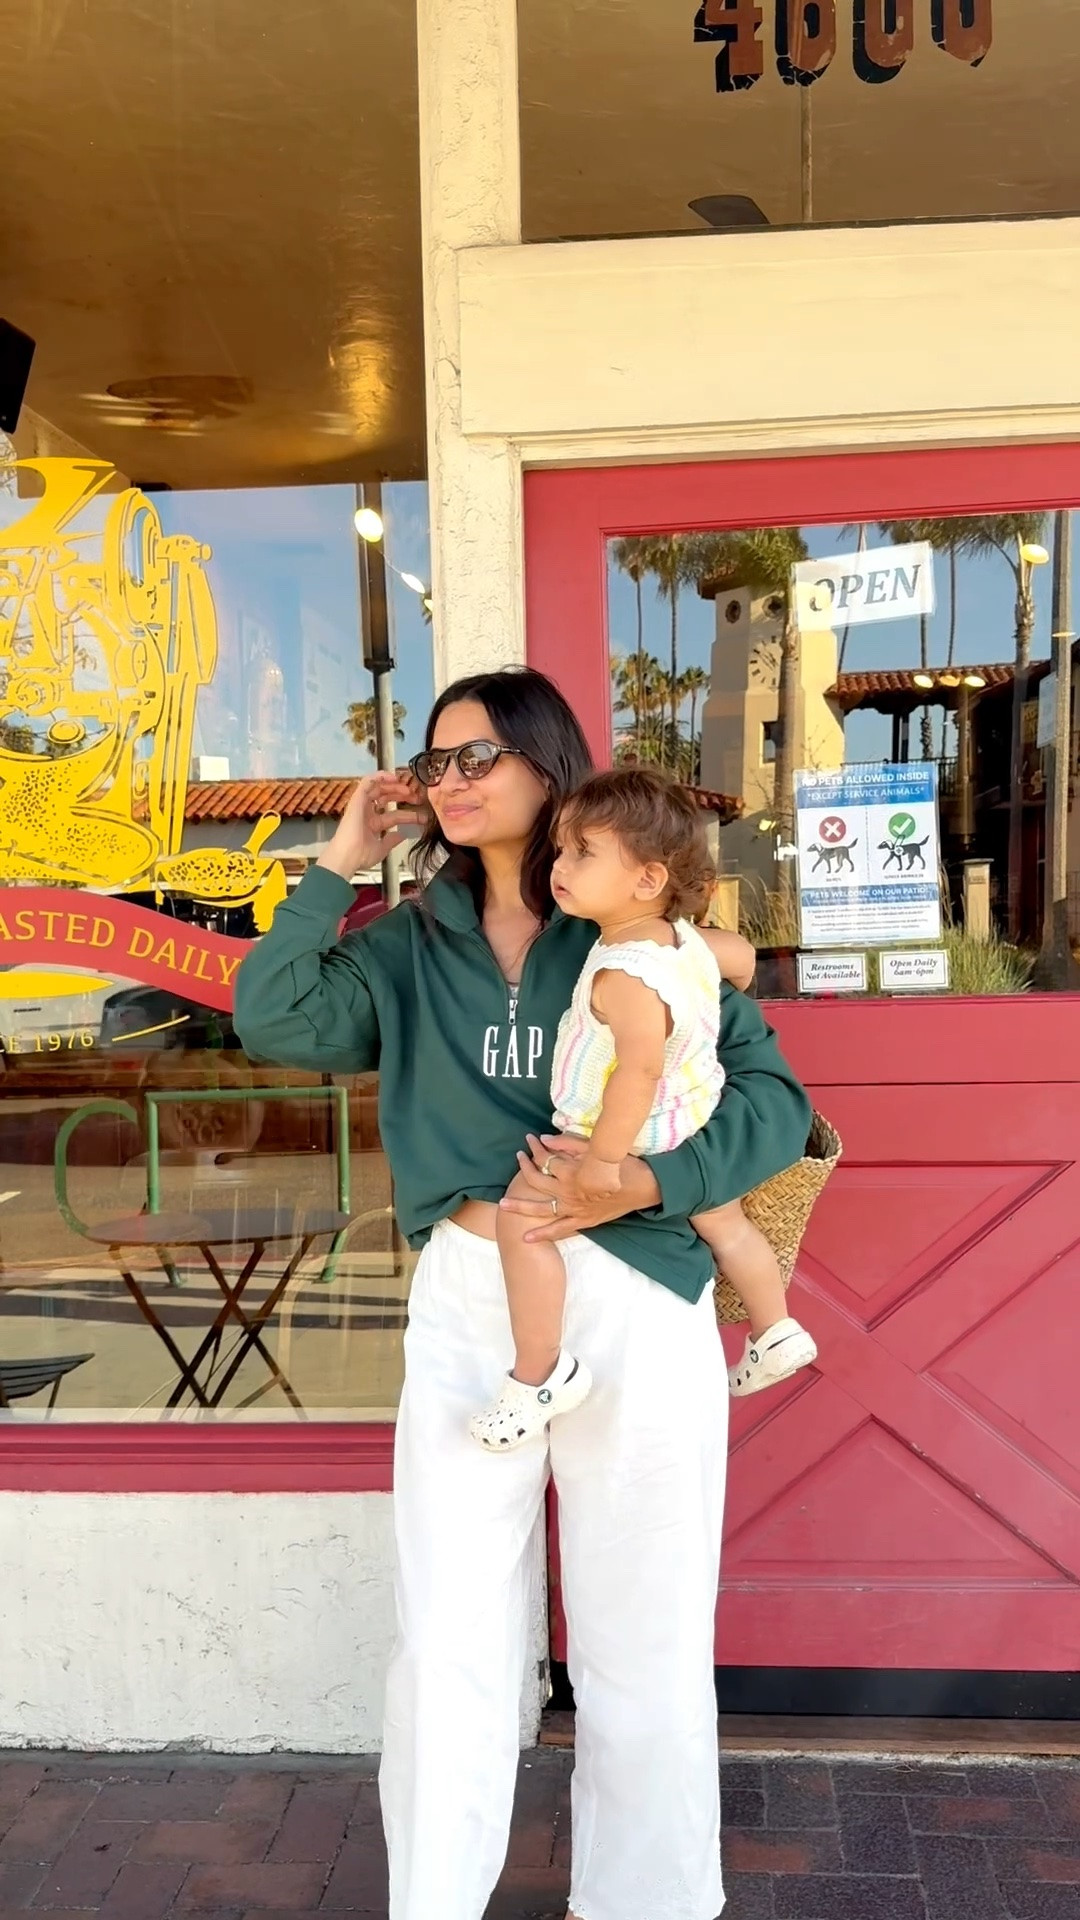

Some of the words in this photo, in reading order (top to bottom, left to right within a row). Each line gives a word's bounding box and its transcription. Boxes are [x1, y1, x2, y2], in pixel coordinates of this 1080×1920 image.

[809, 564, 921, 611] OPEN
[819, 776, 843, 786] PETS
[846, 773, 893, 785] ALLOWED
[896, 771, 929, 782] INSIDE
[844, 788, 878, 799] SERVICE
[831, 889, 870, 898] WELCOME
[872, 888, 883, 896] ON
[885, 887, 902, 895] OUR
[126, 926, 242, 986] DAILY
[811, 963, 854, 971] Restrooms
[890, 960, 912, 970] Open
[914, 958, 938, 968] Daily
[805, 972, 820, 980] Not
[821, 970, 861, 979] Available
[34, 1027, 94, 1053] 1976
[483, 1025, 543, 1078] GAP
